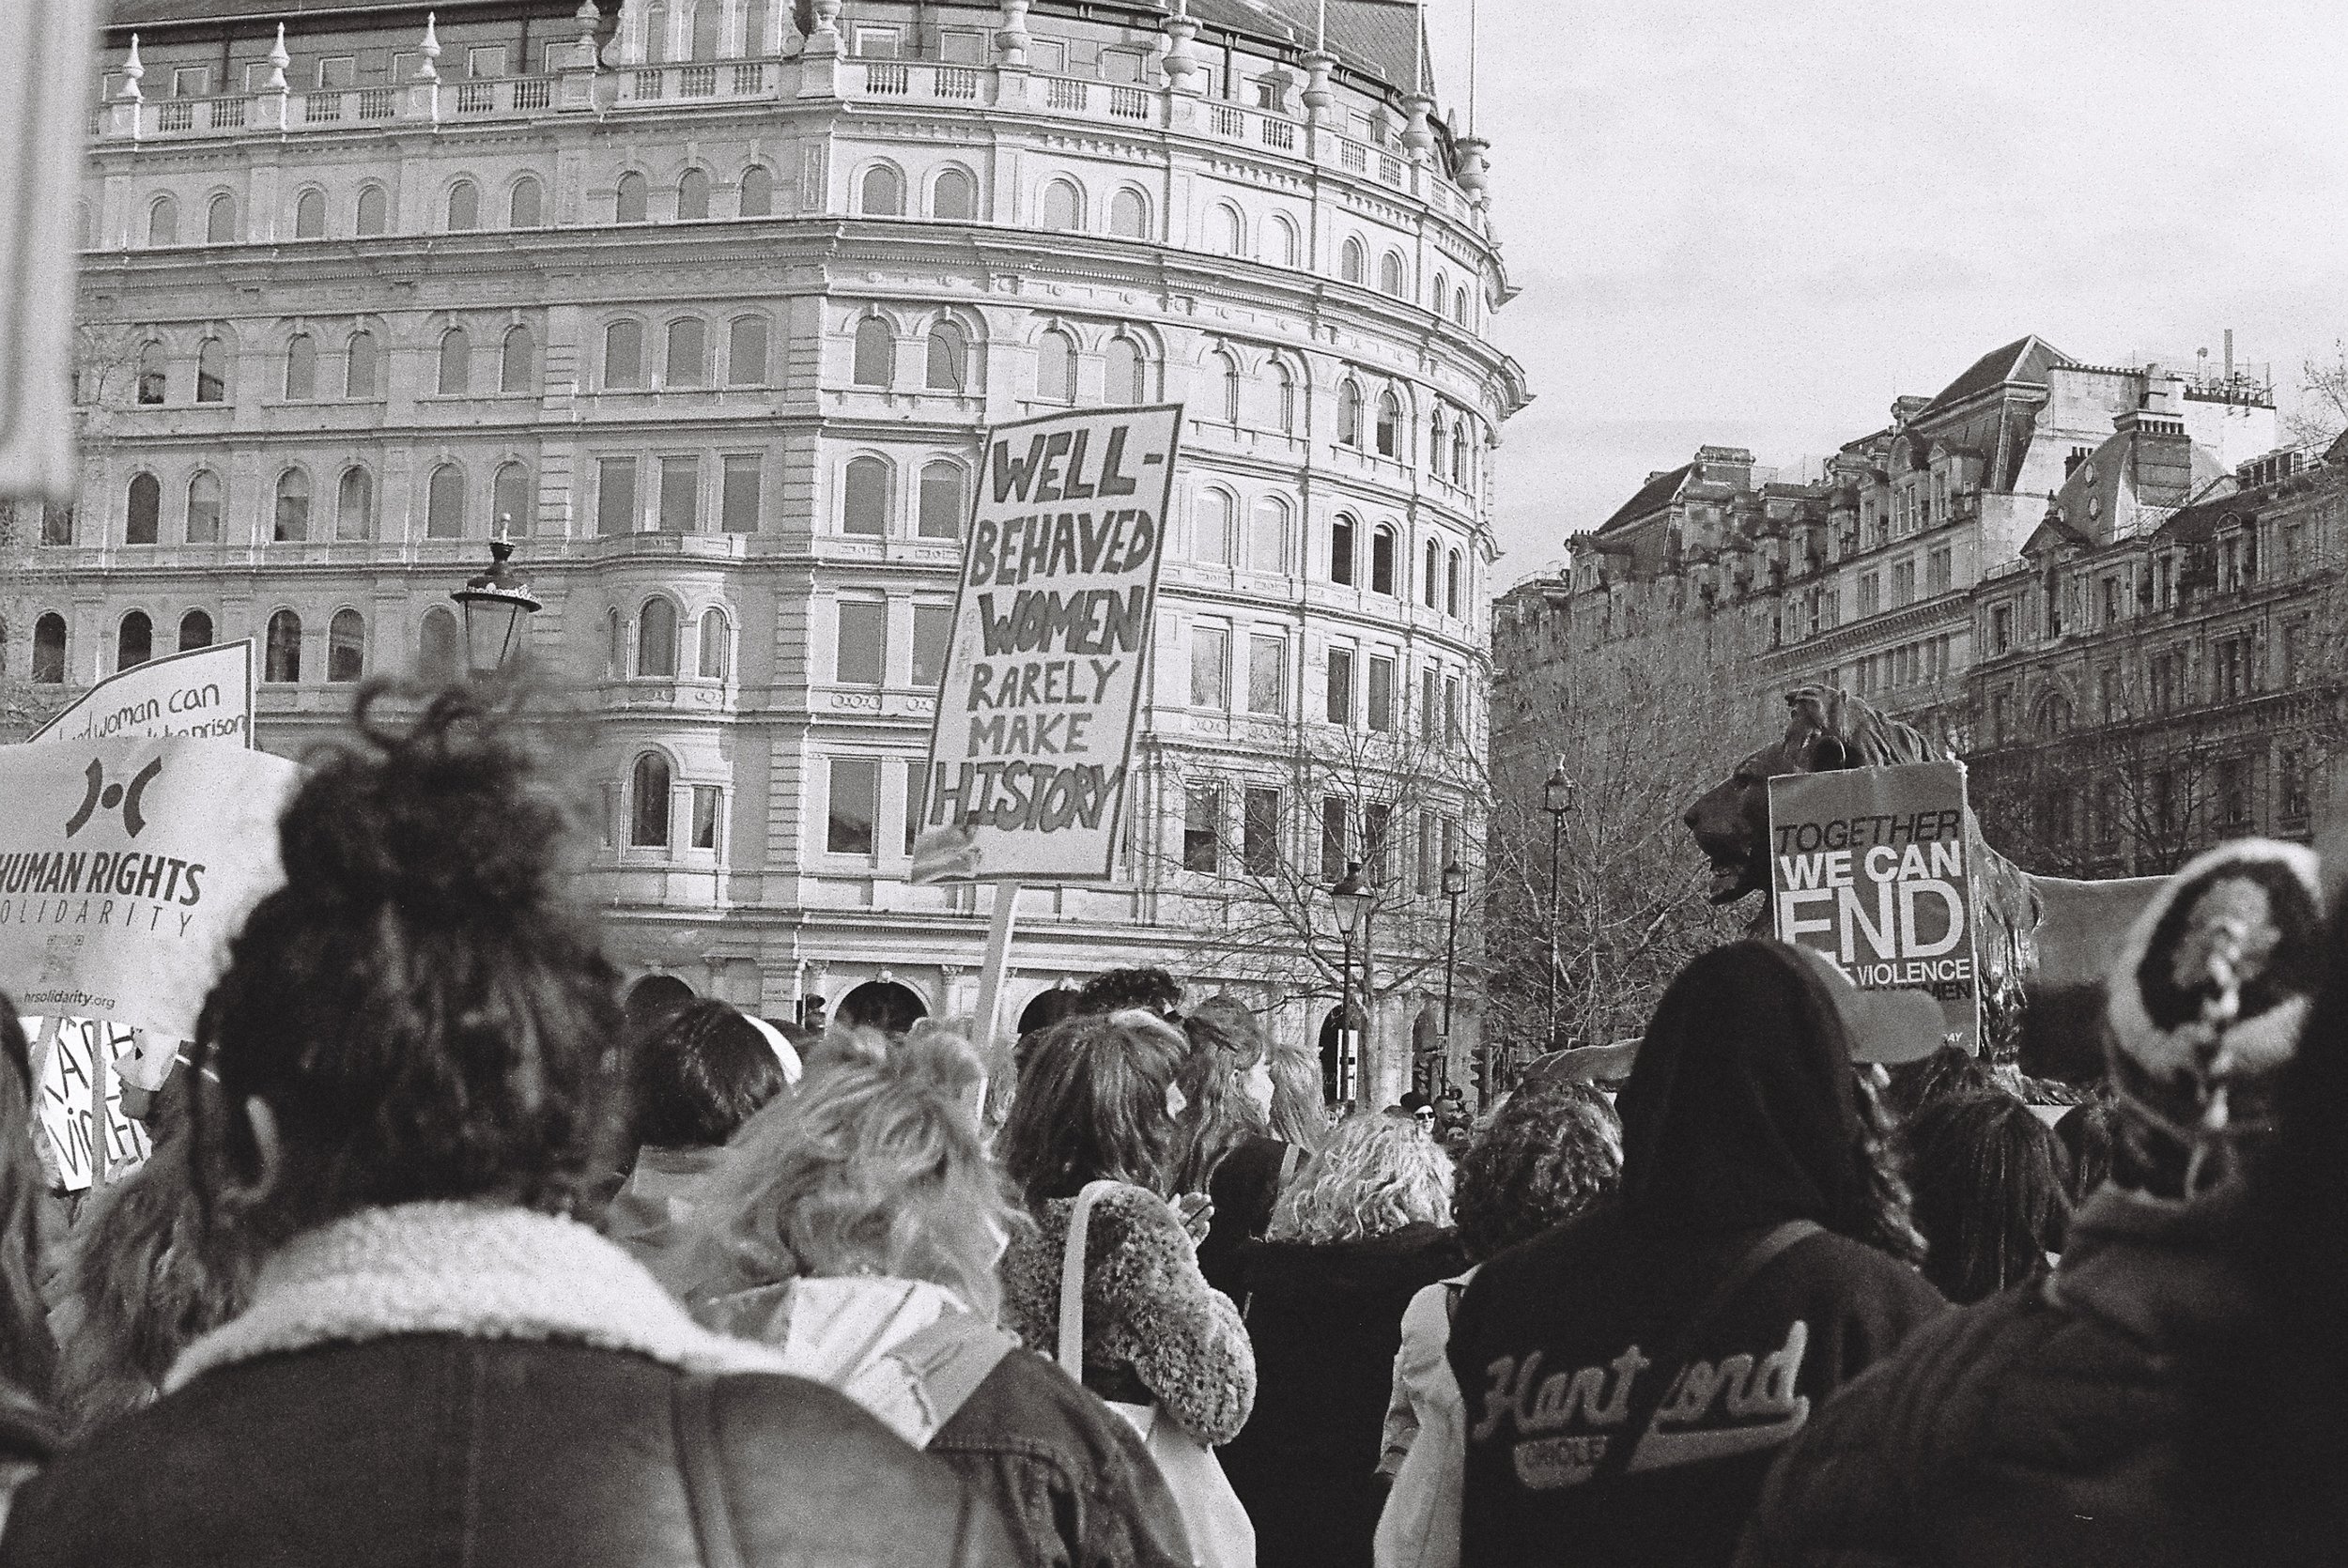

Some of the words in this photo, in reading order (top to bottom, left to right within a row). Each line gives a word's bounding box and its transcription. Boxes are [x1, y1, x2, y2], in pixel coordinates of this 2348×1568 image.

[992, 425, 1164, 504] WELL-
[969, 509, 1156, 588] BEHAVED
[978, 585, 1146, 656] WOMEN
[94, 699, 160, 738] woman
[168, 684, 220, 714] can
[967, 659, 1121, 713] RARELY
[967, 712, 1093, 758] MAKE
[930, 761, 1126, 833] HISTORY
[1774, 809, 1961, 853] TOGETHER
[85, 852, 207, 907] RIGHTS
[1779, 850, 1854, 891] WE
[1864, 839, 1963, 883] CAN
[0, 899, 193, 938] OLIDARITY
[1779, 878, 1965, 963] END
[23, 989, 116, 1010] hrsolidarity.org
[1857, 959, 1971, 986] VIOLENCE
[1942, 1032, 1963, 1042] AY
[1473, 1319, 1810, 1441] Hartord
